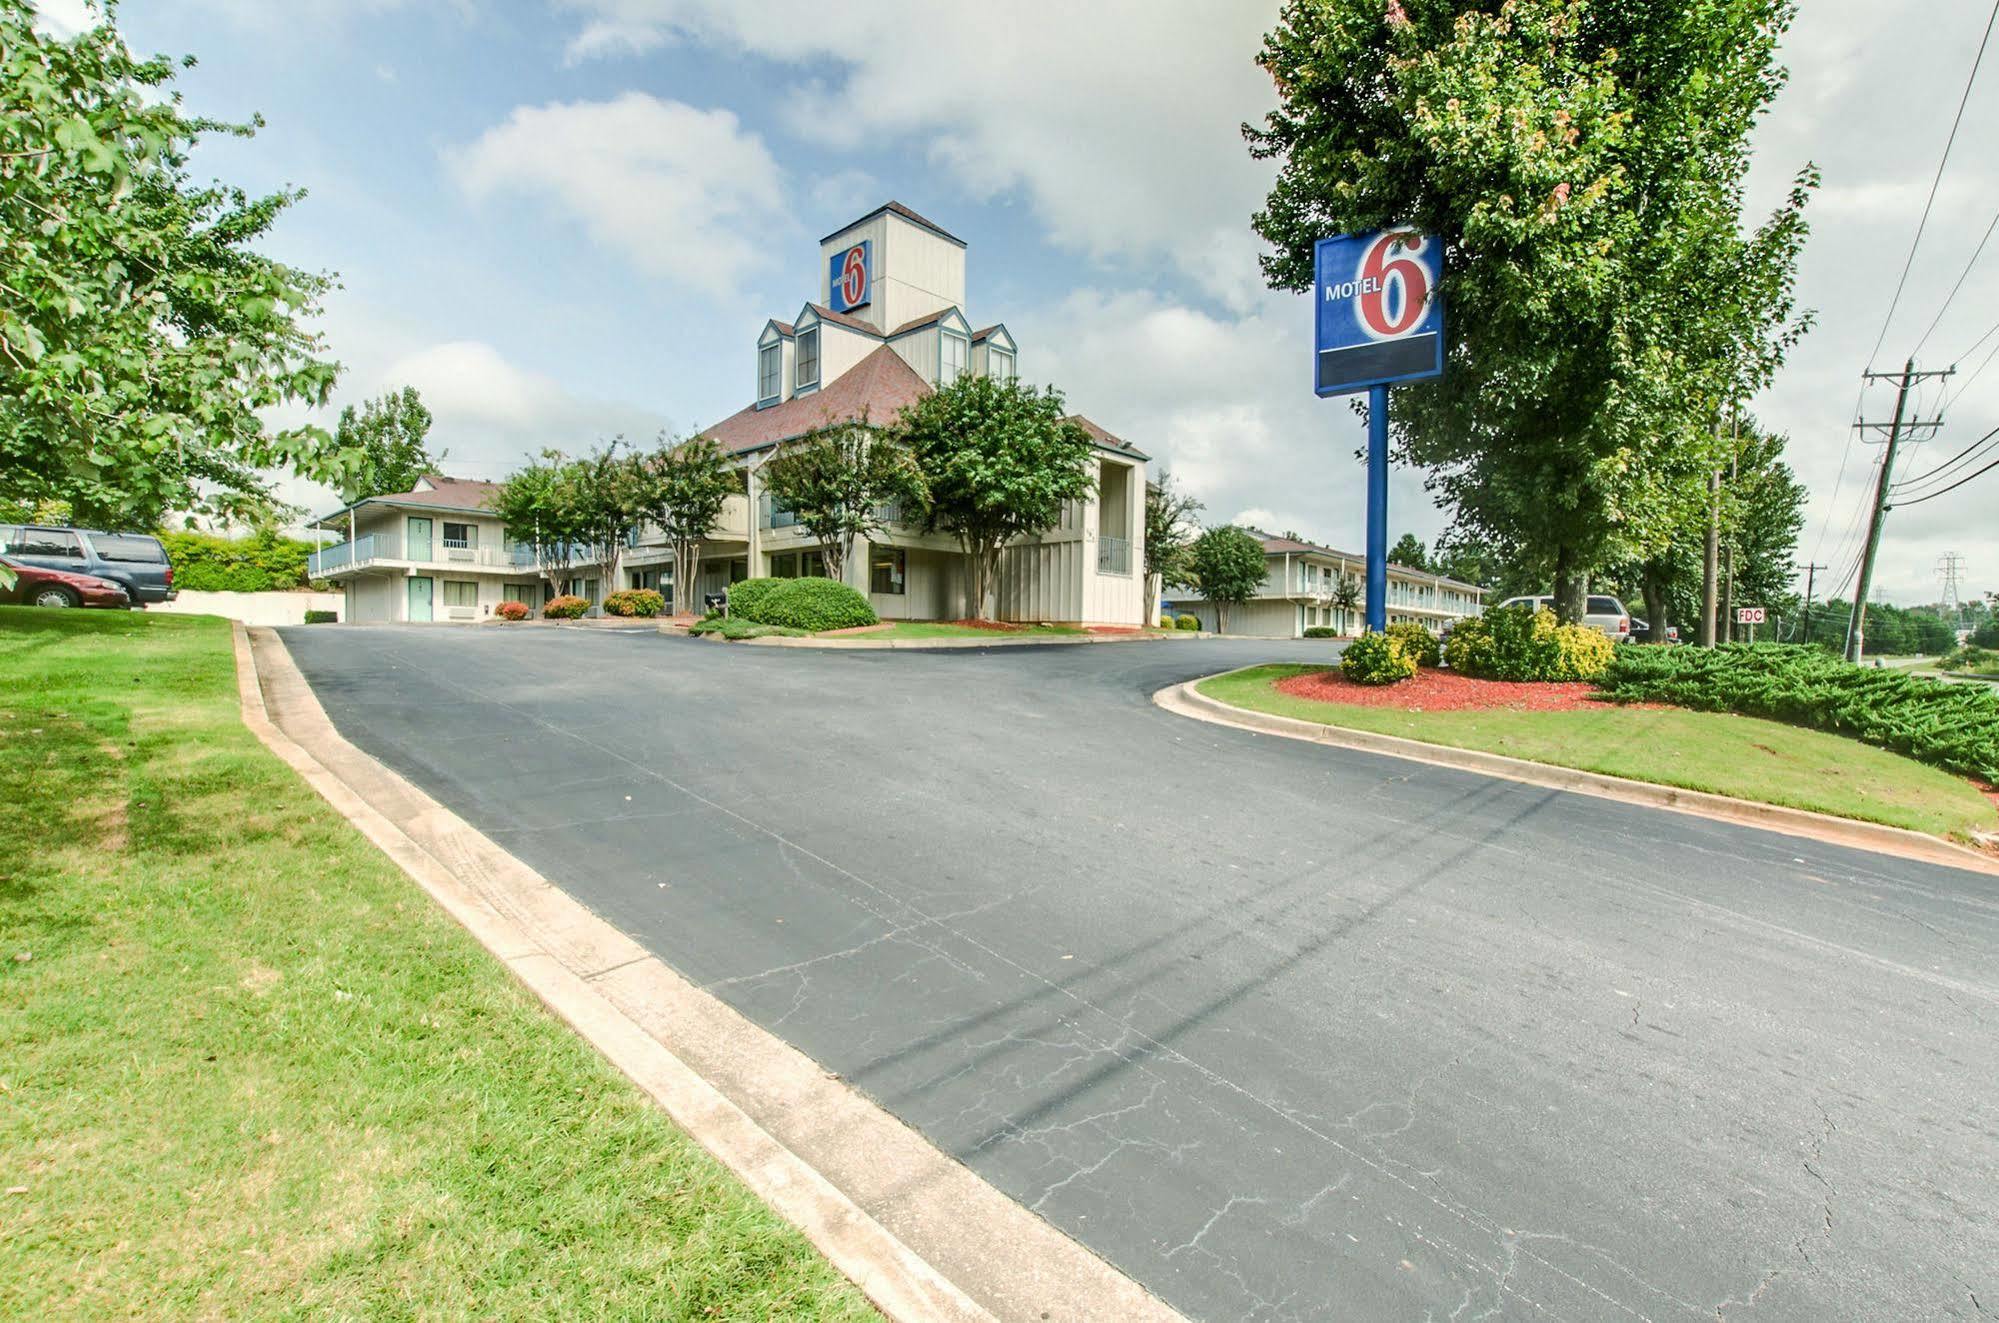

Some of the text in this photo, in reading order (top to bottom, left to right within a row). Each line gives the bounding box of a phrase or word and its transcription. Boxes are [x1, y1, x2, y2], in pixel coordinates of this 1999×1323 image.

[843, 247, 865, 305] 6
[1326, 229, 1430, 338] MOTEL 6
[1739, 609, 1762, 622] FDC
